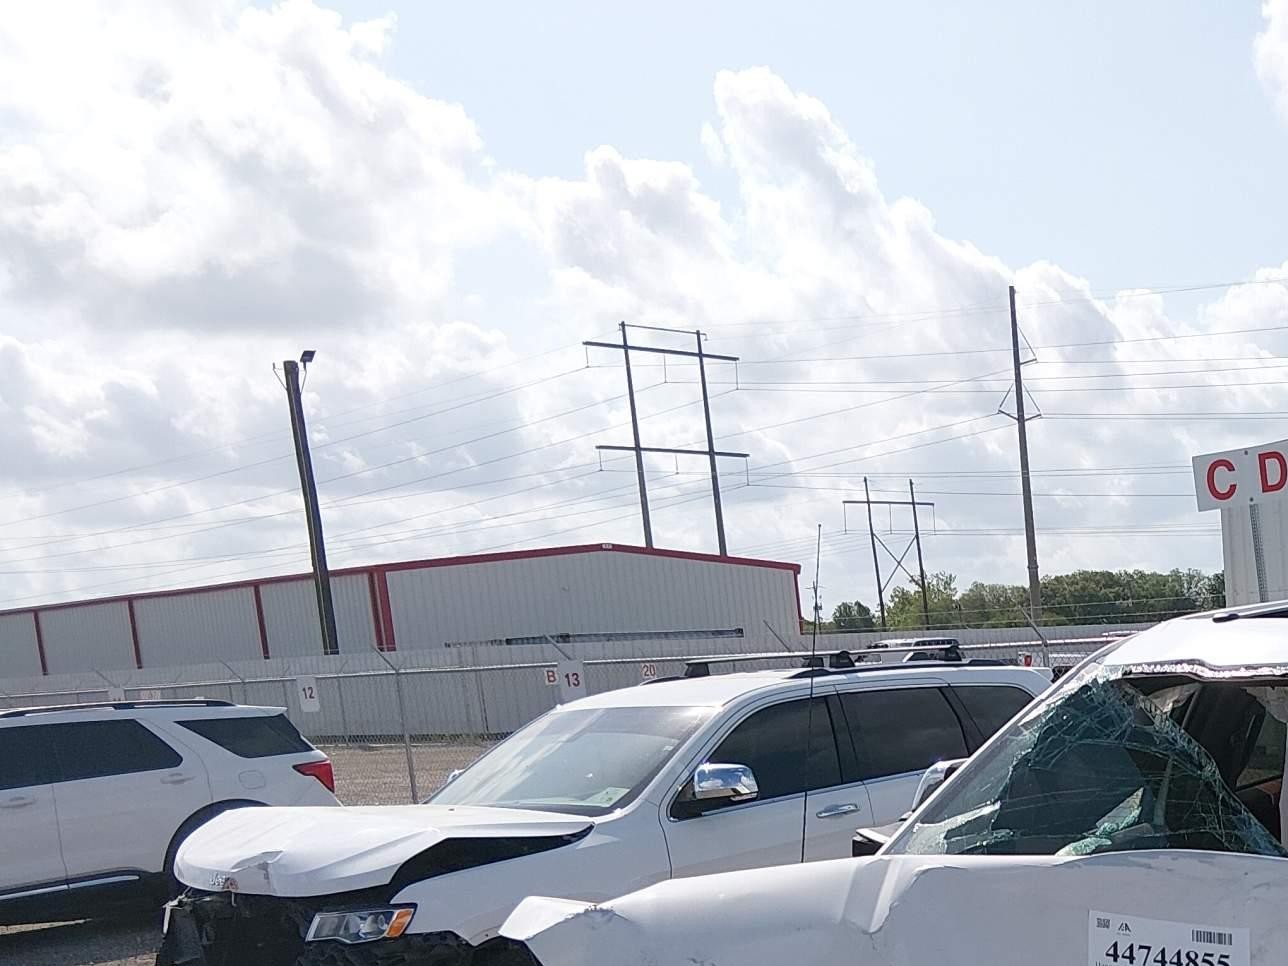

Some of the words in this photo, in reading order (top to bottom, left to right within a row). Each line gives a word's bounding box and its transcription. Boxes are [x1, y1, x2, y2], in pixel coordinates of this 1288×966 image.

[1206, 458, 1238, 501] C
[1257, 451, 1288, 494] D
[546, 669, 557, 683] B
[642, 664, 656, 677] 20
[564, 672, 581, 688] 13
[302, 686, 316, 700] 12
